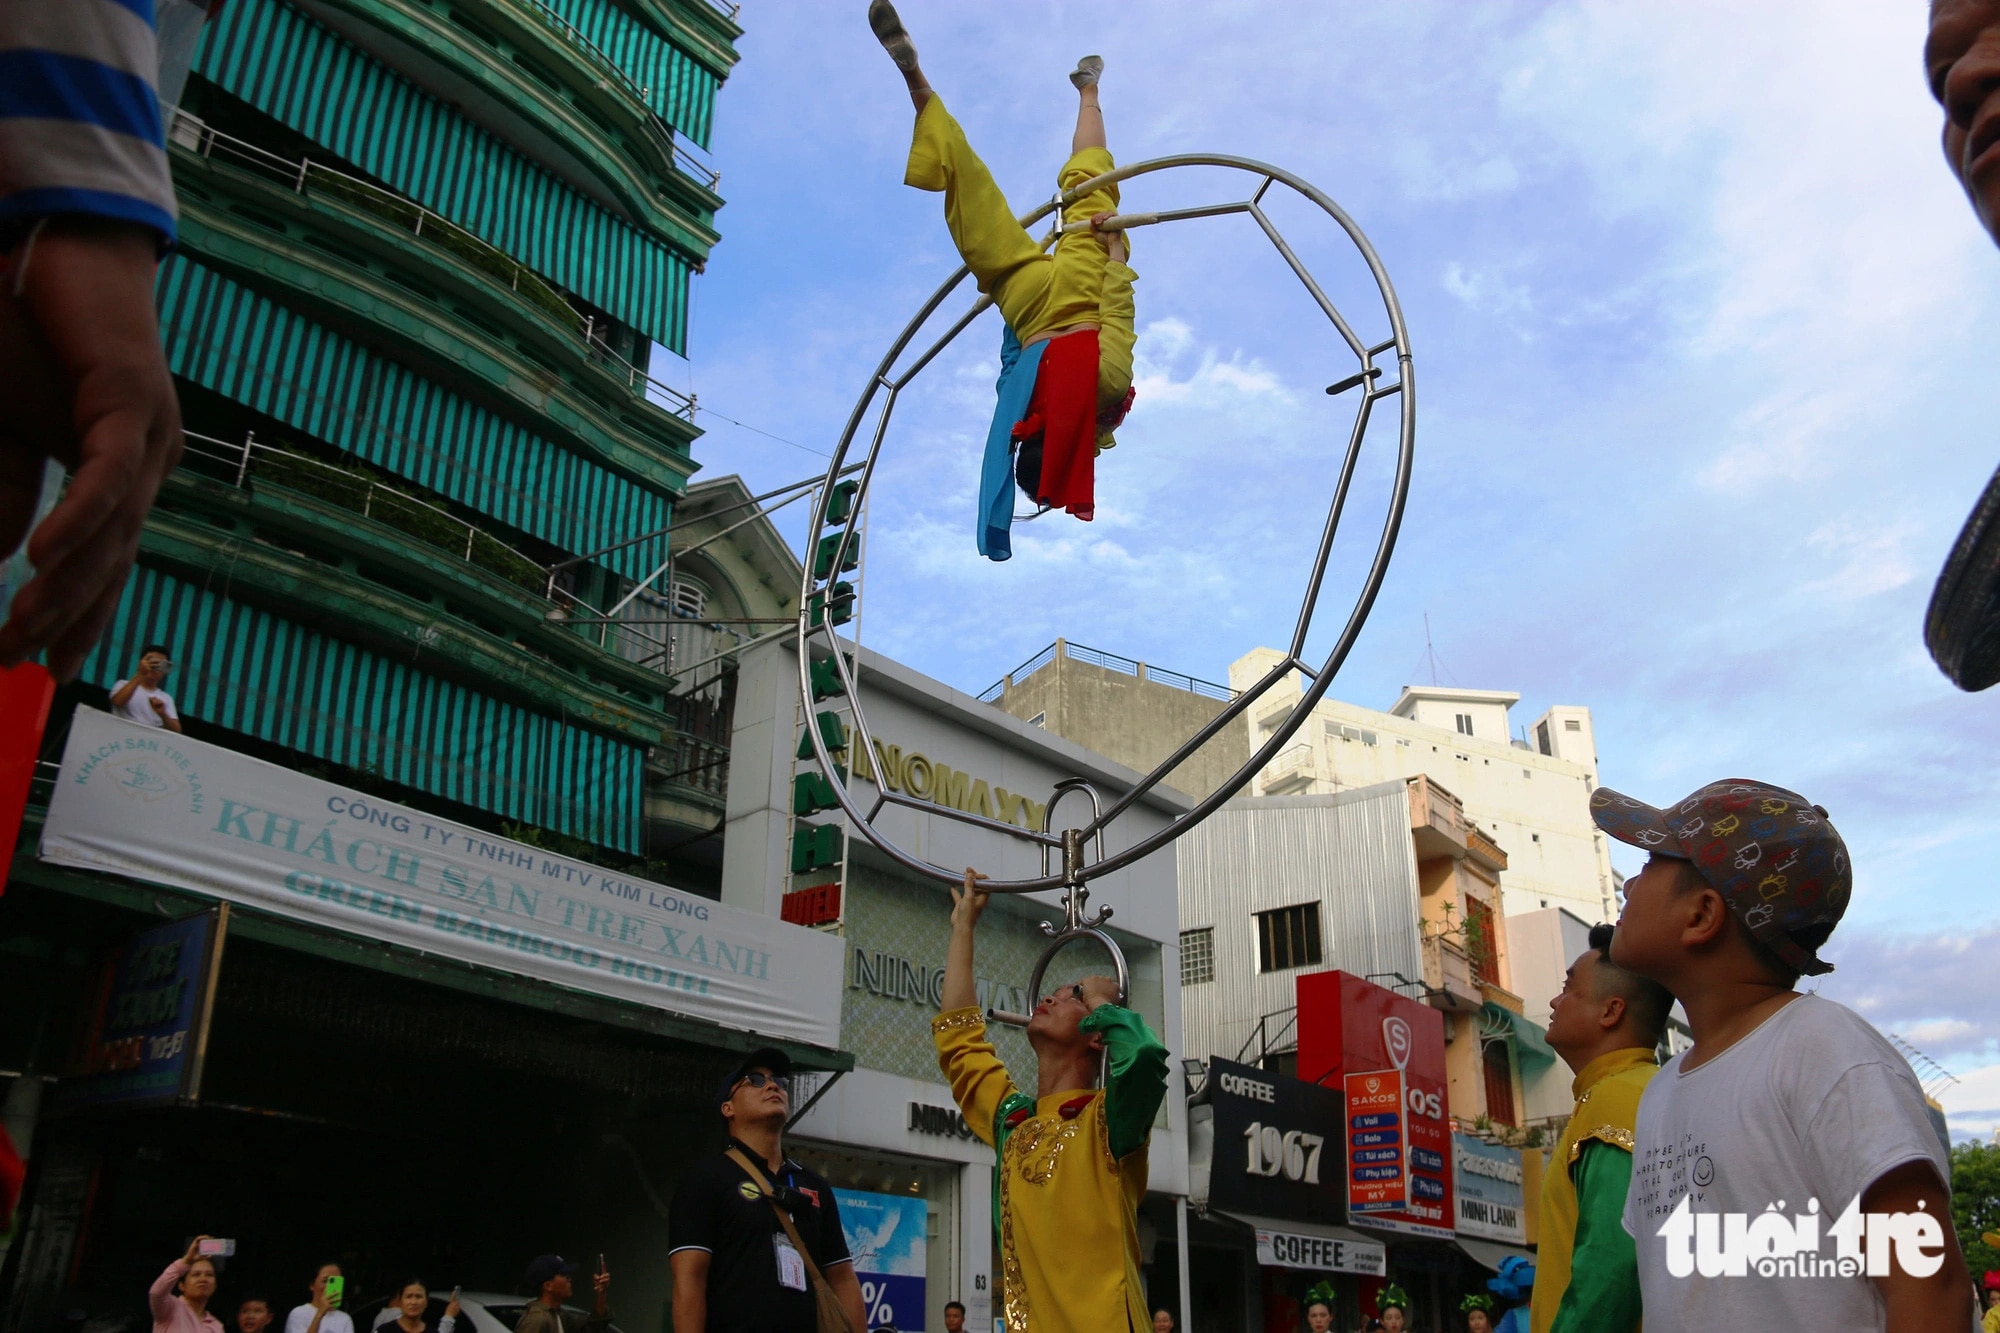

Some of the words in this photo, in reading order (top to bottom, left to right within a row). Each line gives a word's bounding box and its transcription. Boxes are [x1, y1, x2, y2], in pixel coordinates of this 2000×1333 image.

[327, 795, 412, 833] CÔNG
[421, 823, 455, 845] TY
[464, 836, 534, 870] TNHH
[542, 860, 593, 887] MTV
[600, 878, 642, 903] KIM
[648, 891, 710, 922] LONG
[211, 797, 424, 888] KHÁCH
[438, 863, 543, 915] SẠN
[556, 894, 647, 948] TRE
[657, 924, 772, 981] XANH
[285, 869, 423, 925] GREEN
[1220, 1072, 1276, 1104] COFFEE
[1351, 1093, 1397, 1105] SAKOS
[1406, 1087, 1442, 1120] OS
[906, 1101, 985, 1144] NINO
[1363, 1117, 1379, 1126] Vali
[1243, 1121, 1325, 1185] 1967
[1363, 1134, 1382, 1143] Balo
[1455, 1143, 1522, 1184] Panasonic
[1659, 1159, 1673, 1170] TO
[1460, 1198, 1489, 1224] MINH
[1273, 1234, 1345, 1268] COFFEE
[975, 1274, 987, 1291] 63
